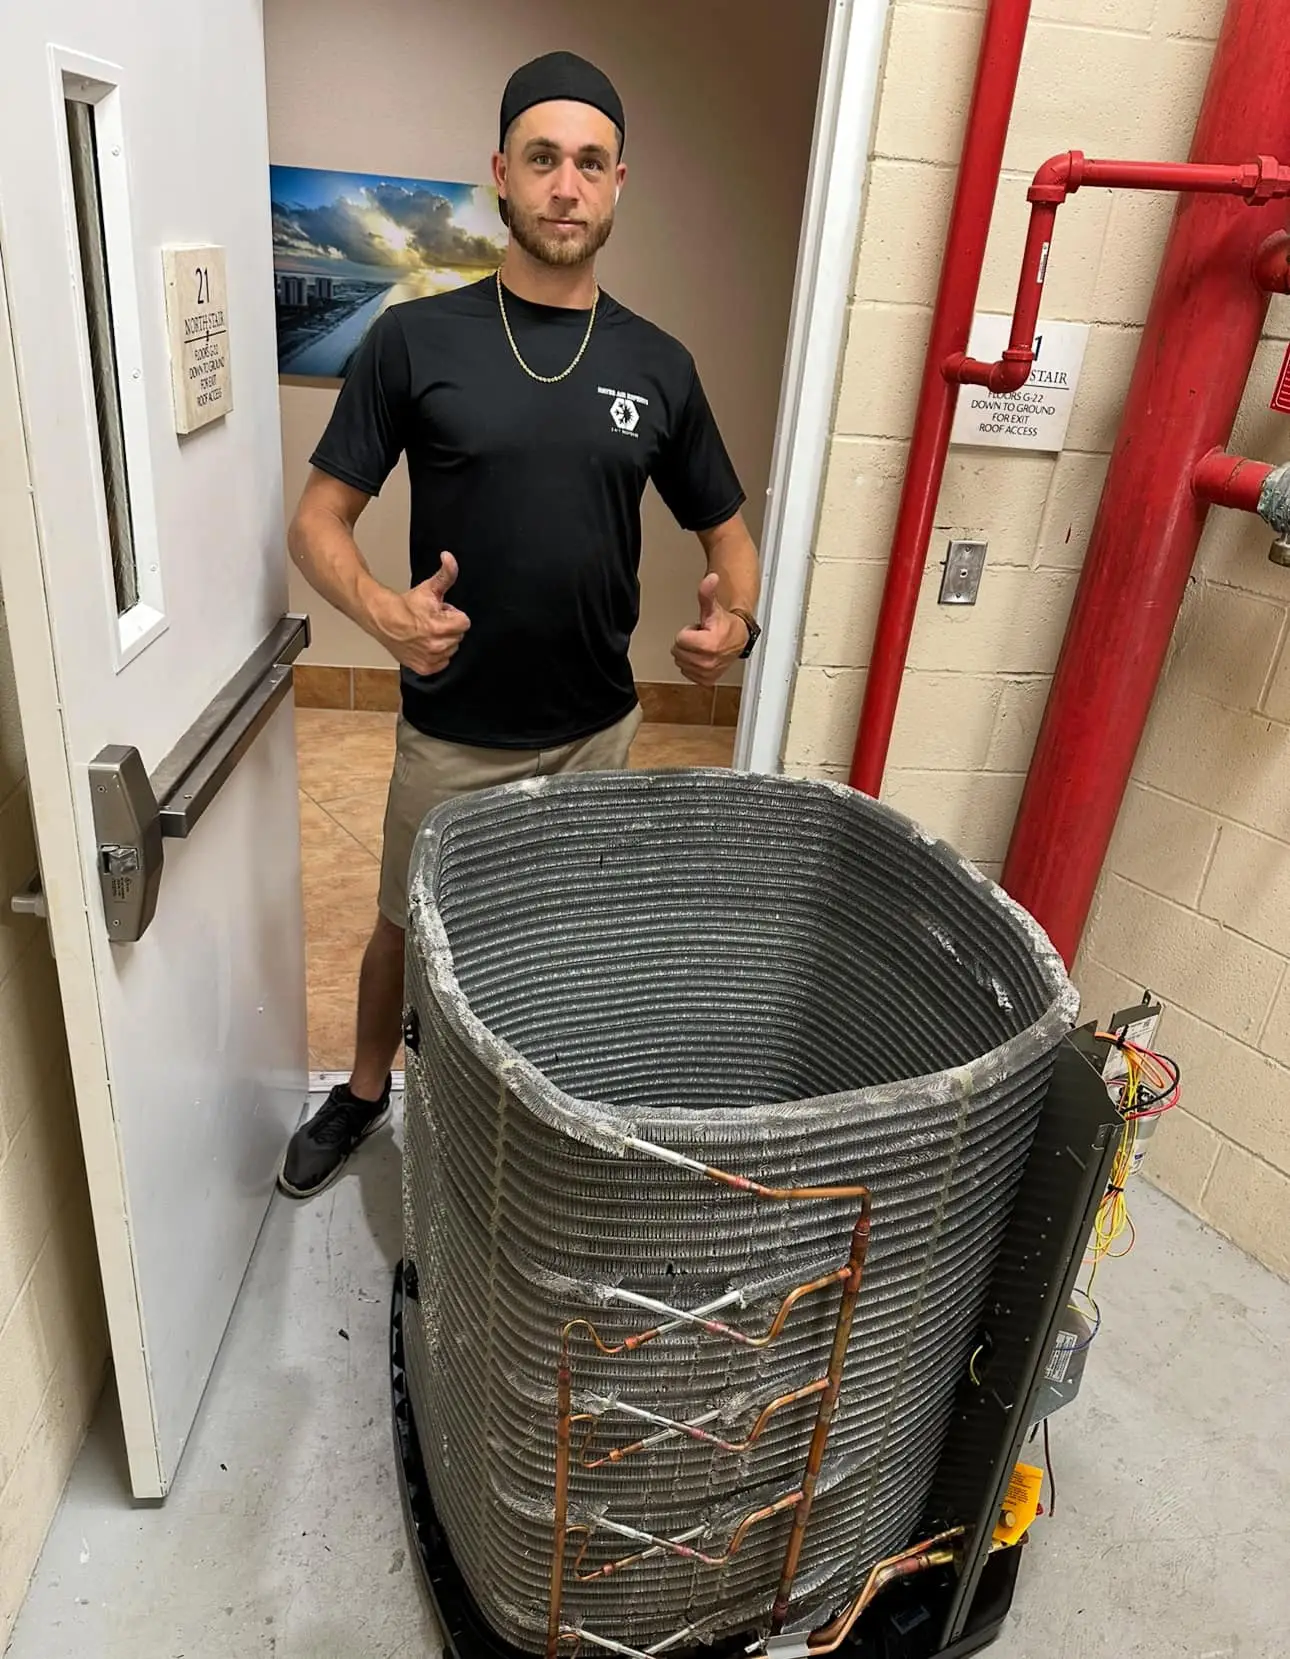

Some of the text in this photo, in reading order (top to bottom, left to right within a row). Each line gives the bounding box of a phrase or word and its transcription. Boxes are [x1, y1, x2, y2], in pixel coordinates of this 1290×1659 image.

[195, 267, 210, 305] 21
[184, 311, 224, 335] NORTH STAIR
[1034, 335, 1043, 361] 1
[1029, 369, 1068, 385] STAIR
[1023, 393, 1044, 403] G-22
[971, 400, 1056, 416] DOWN TO GROUND
[992, 412, 1030, 424] FOR EXIT
[979, 423, 1038, 437] ROOF ACCESS
